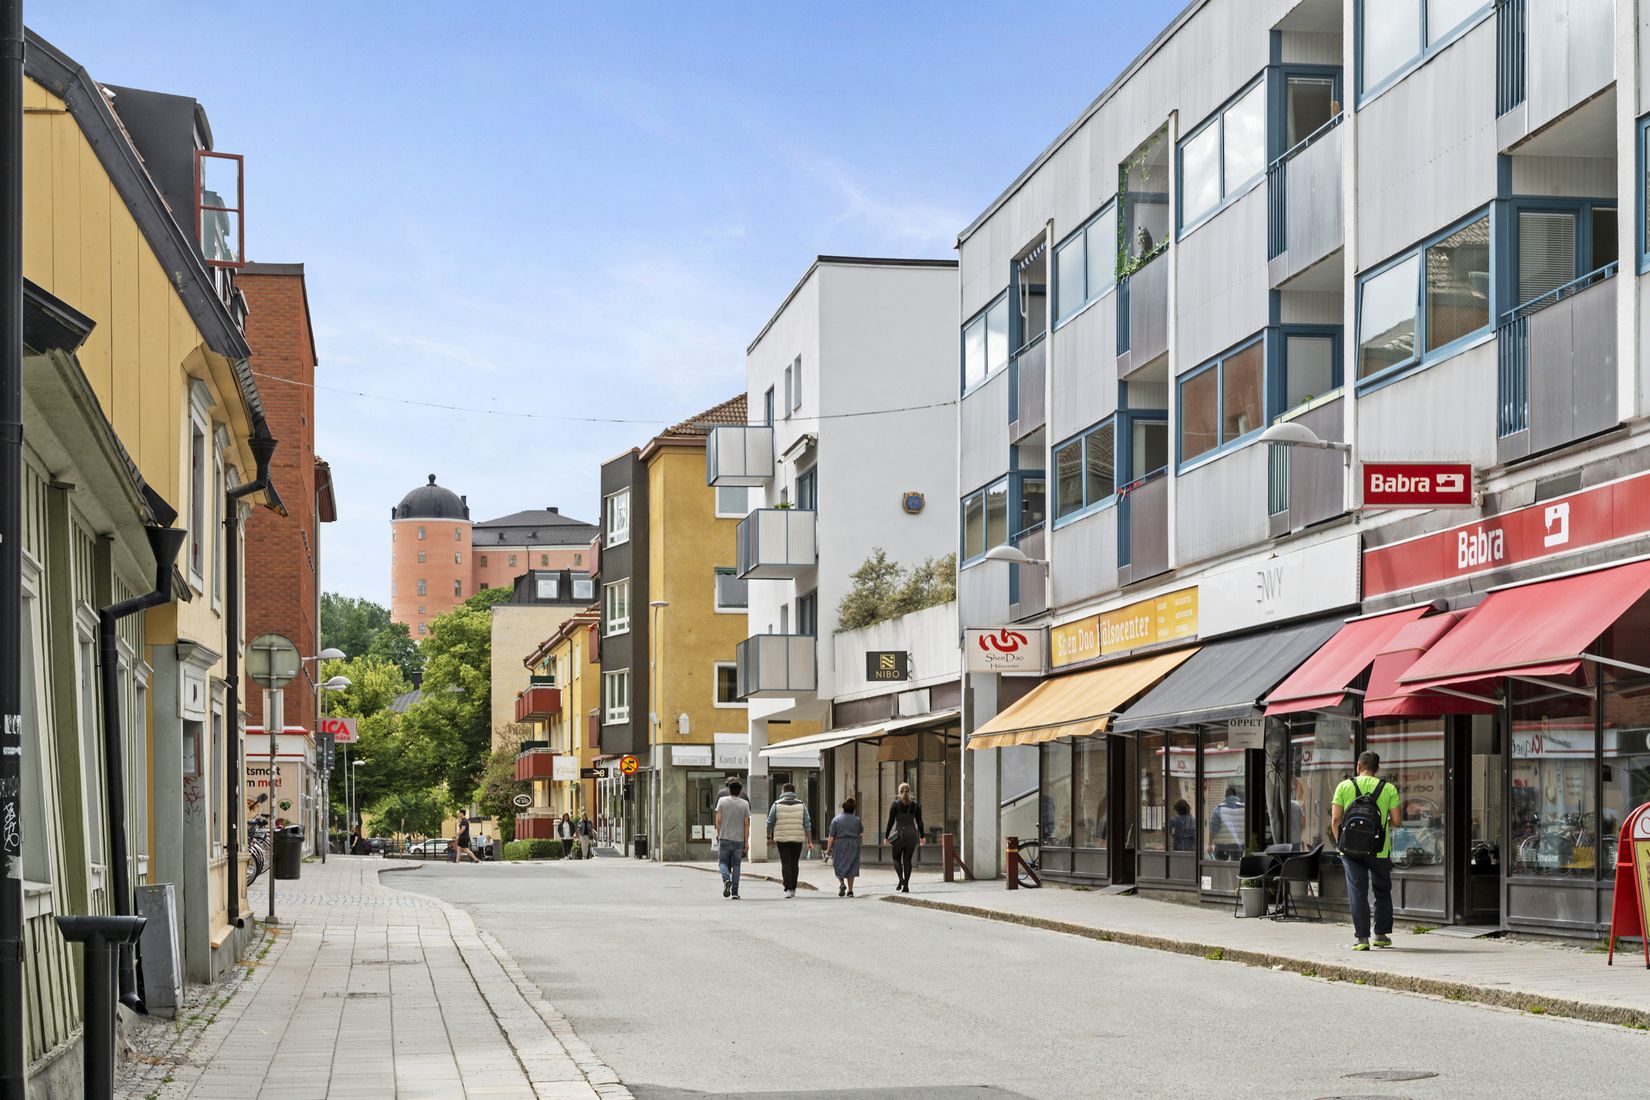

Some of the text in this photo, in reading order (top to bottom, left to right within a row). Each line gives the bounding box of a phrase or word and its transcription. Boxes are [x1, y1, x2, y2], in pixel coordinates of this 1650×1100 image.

[1370, 473, 1430, 492] Babra
[1457, 526, 1504, 569] Babra
[1057, 633, 1077, 657] Shen
[1078, 628, 1095, 651] Dao
[875, 670, 900, 678] NIBO
[321, 720, 351, 735] ICA
[719, 755, 737, 765] Konst
